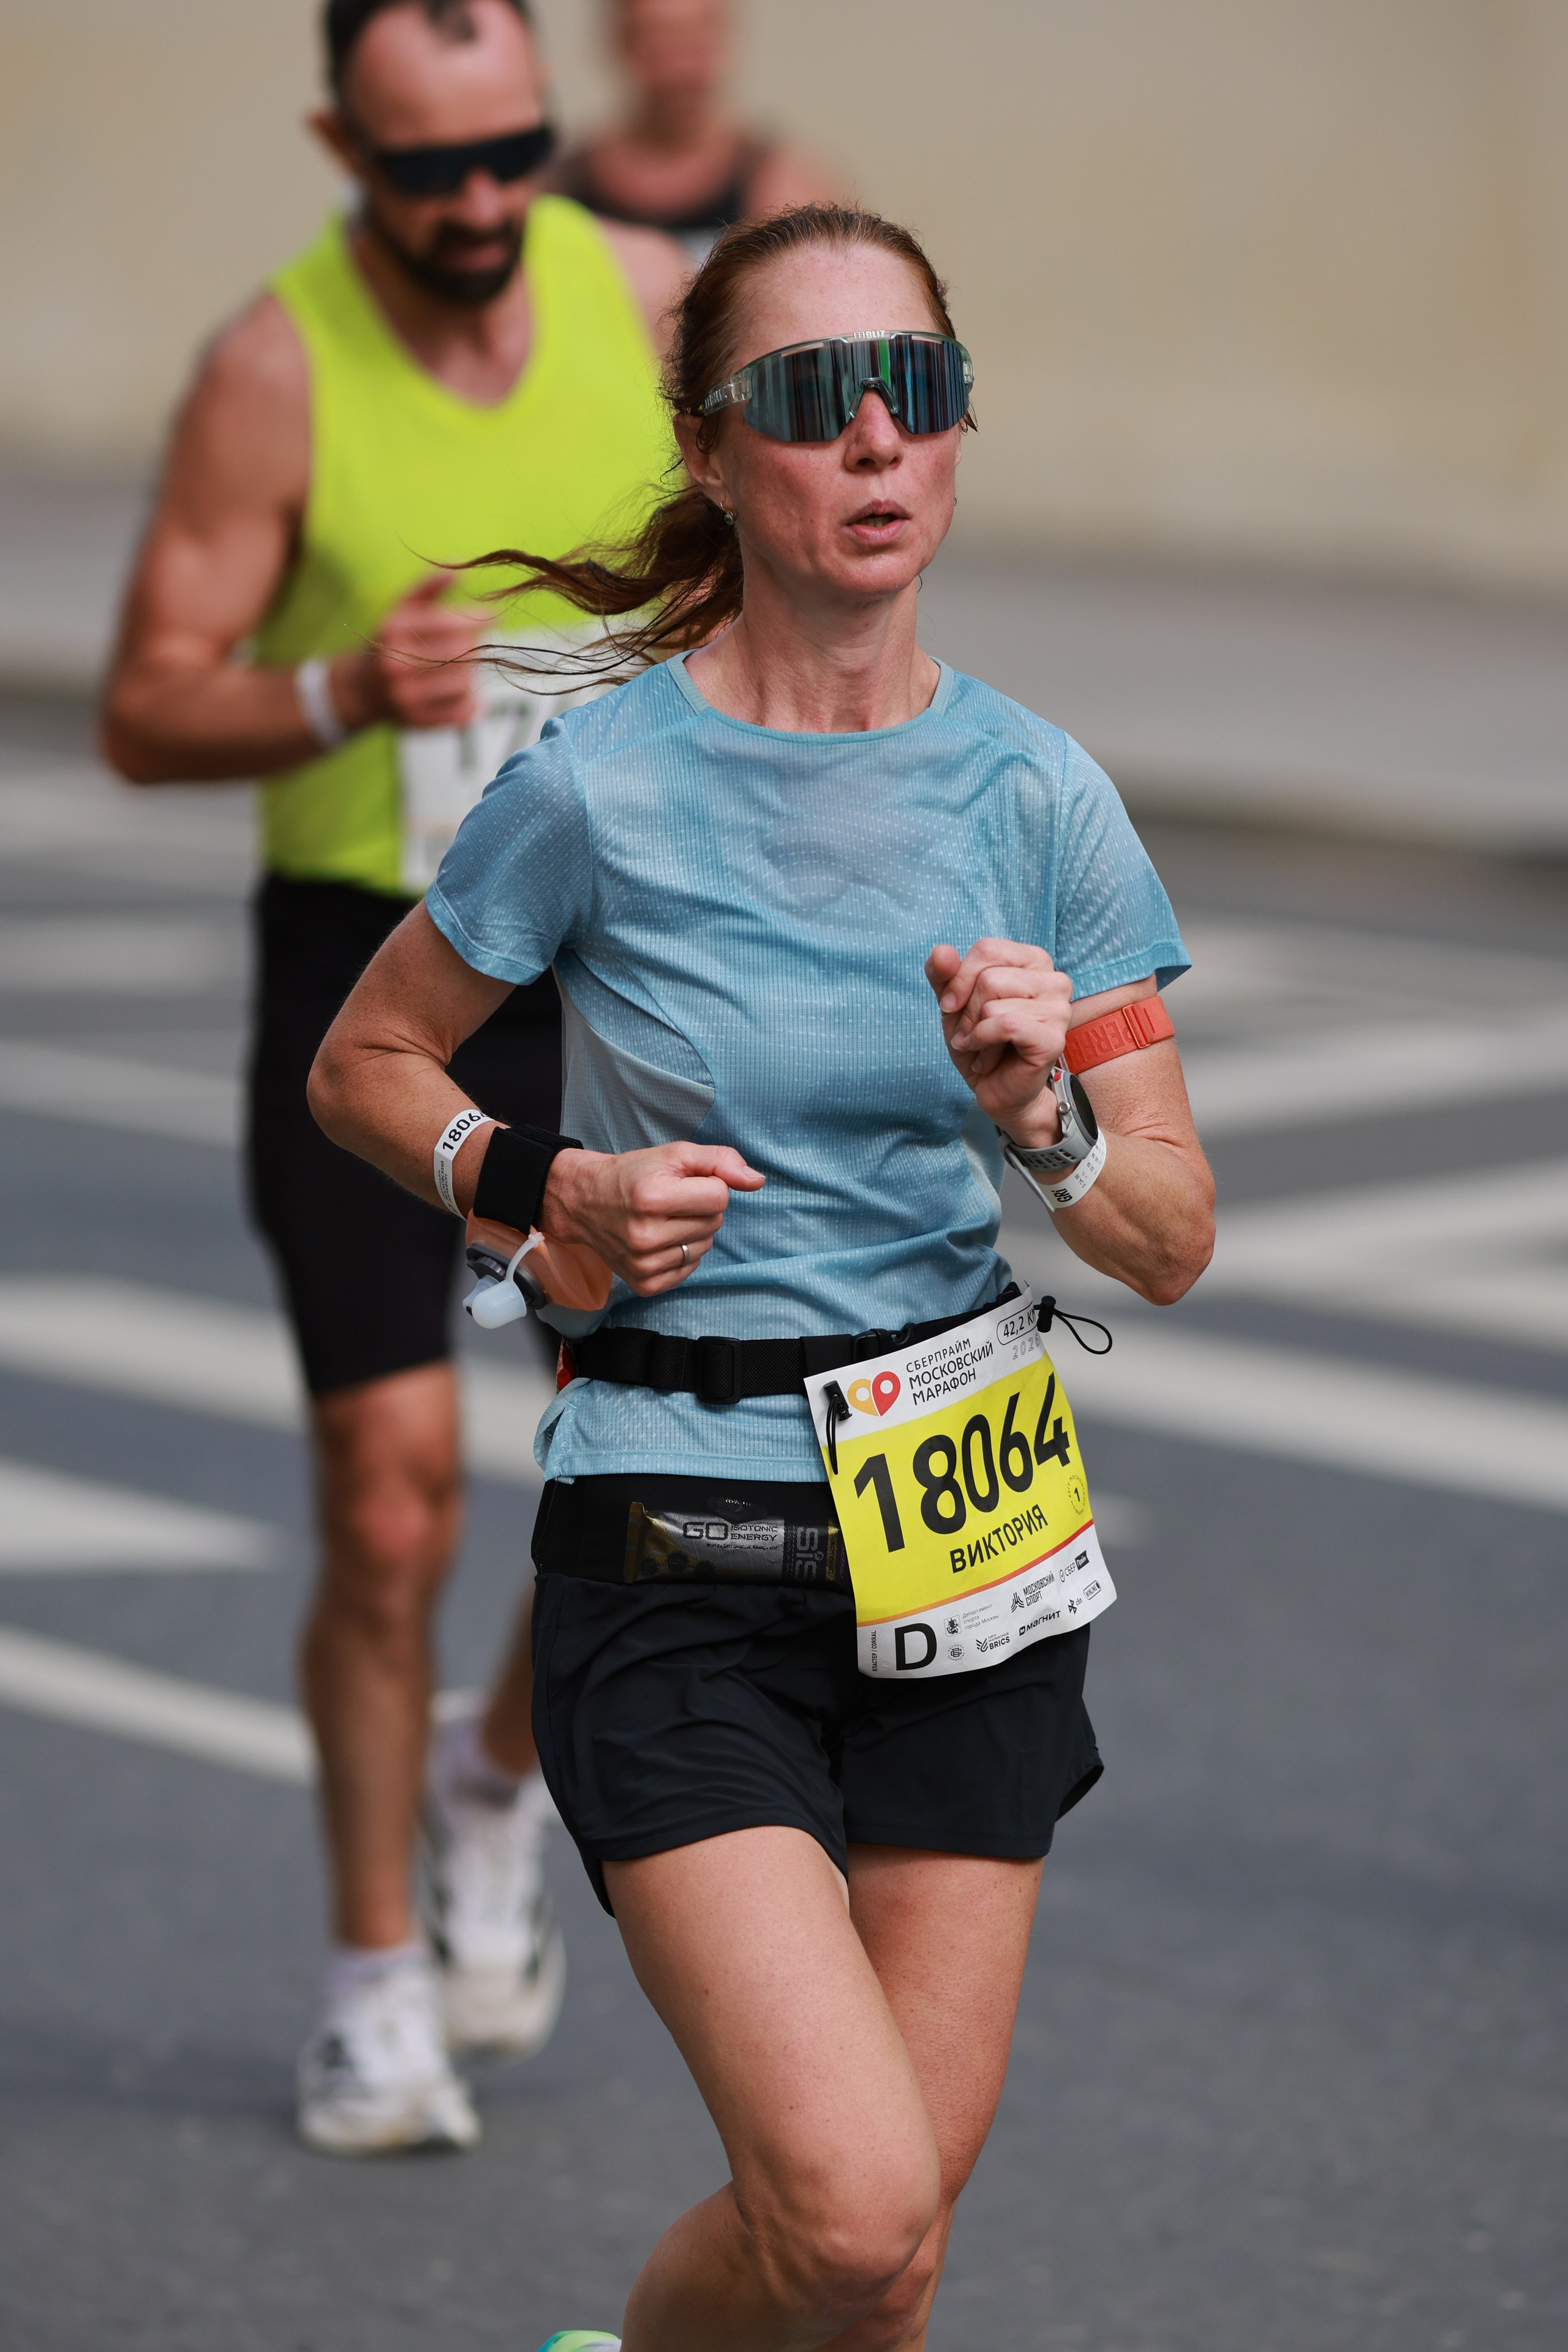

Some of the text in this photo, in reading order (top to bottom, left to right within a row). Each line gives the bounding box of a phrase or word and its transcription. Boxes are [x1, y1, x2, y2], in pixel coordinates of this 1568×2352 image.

[865, 330, 886, 339] BLIZ
[1003, 1315, 1025, 1338] 42,2
[906, 1338, 971, 1373] СБЕРПРАЙМ
[908, 1340, 993, 1390] МОСКОВСКИЙ
[912, 1368, 976, 1406] МАРАФОН
[853, 1371, 1071, 1553] 18064
[1074, 1487, 1080, 1502] 1
[683, 1521, 728, 1540] GO
[730, 1523, 778, 1534] ISOTONIC
[730, 1532, 778, 1542] ENERGY
[949, 1504, 1049, 1574] ВИКТОРИЯ
[1064, 1562, 1076, 1577] СБЕР
[1023, 1571, 1055, 1597] МОСКОВСКИЙ
[1085, 1585, 1098, 1598] WINLINE
[1025, 1591, 1043, 1607] СПОРТ
[962, 1604, 992, 1619] Департамент
[963, 1615, 979, 1624] спорта
[964, 1615, 999, 1630] города Москвы
[894, 1623, 937, 1671] D
[989, 1636, 1010, 1650] BRICS
